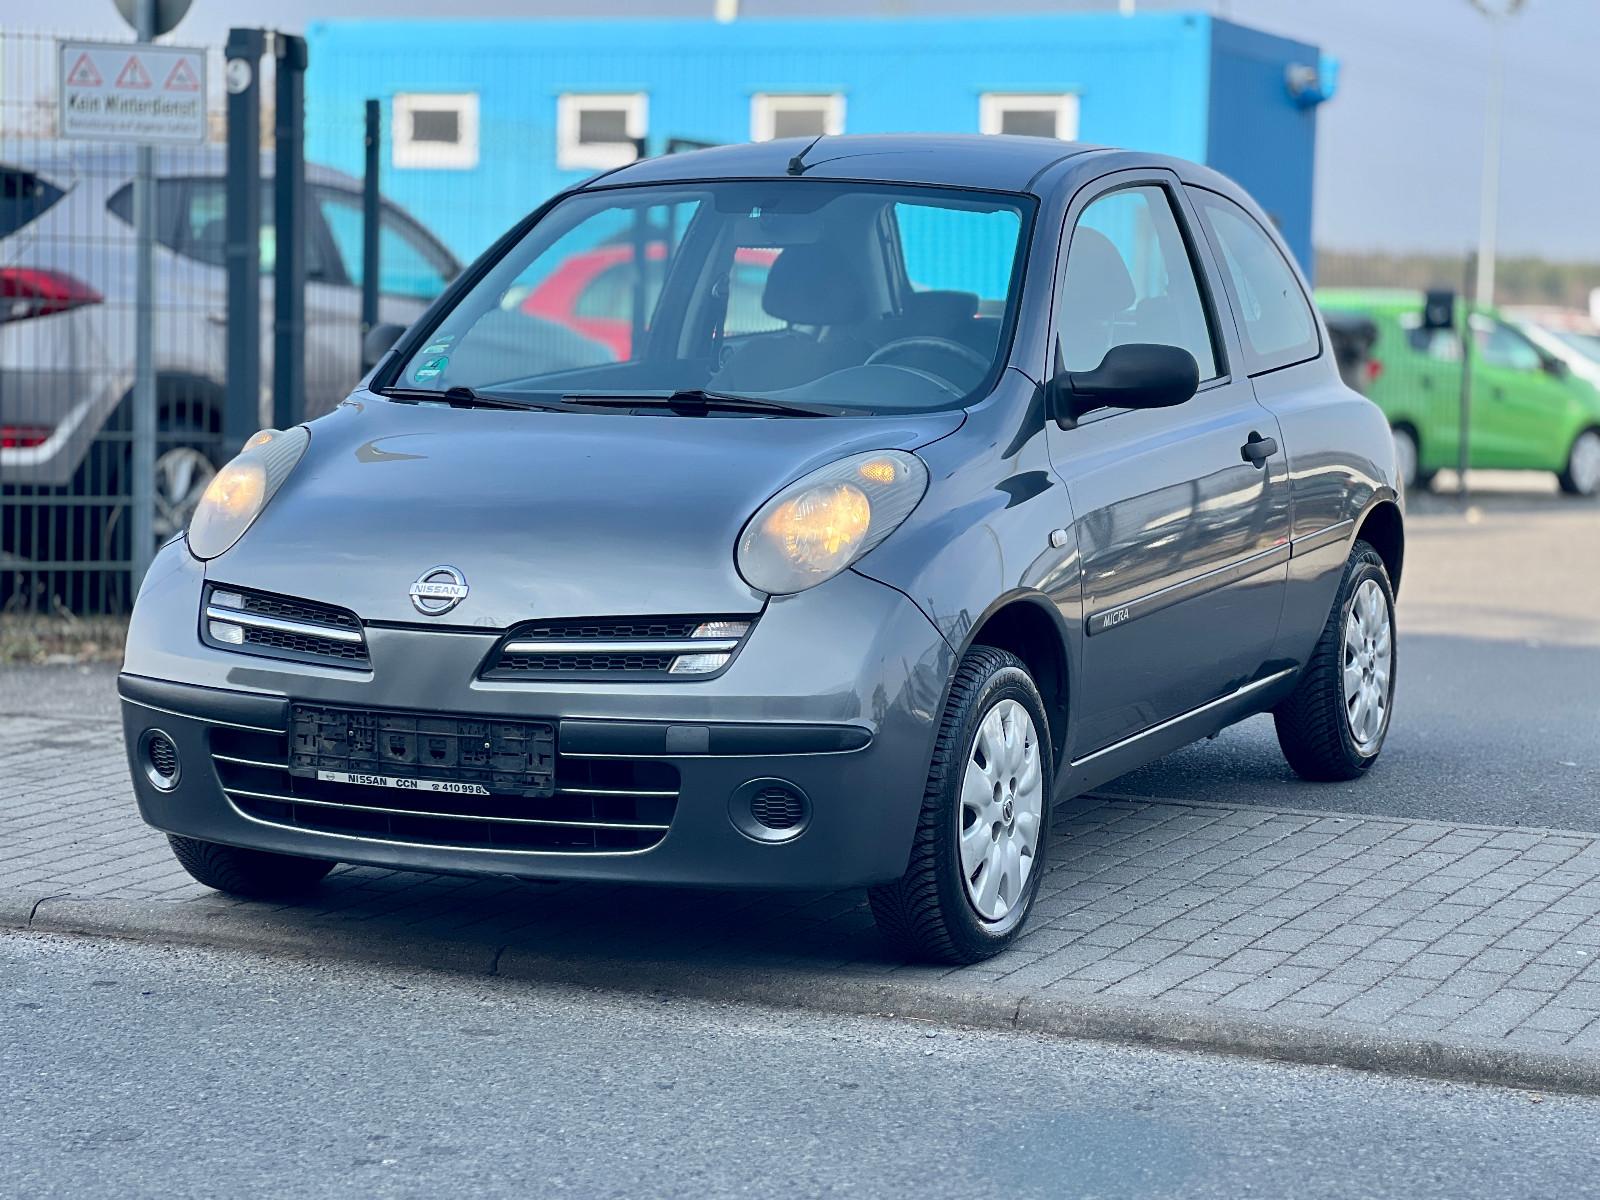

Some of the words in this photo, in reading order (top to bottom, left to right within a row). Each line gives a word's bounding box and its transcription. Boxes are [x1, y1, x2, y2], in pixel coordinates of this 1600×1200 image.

[69, 94, 98, 113] Kein
[414, 584, 461, 595] NISSAN
[1103, 608, 1129, 628] MICRA
[348, 774, 387, 786] NISSAN
[395, 778, 418, 789] CCN
